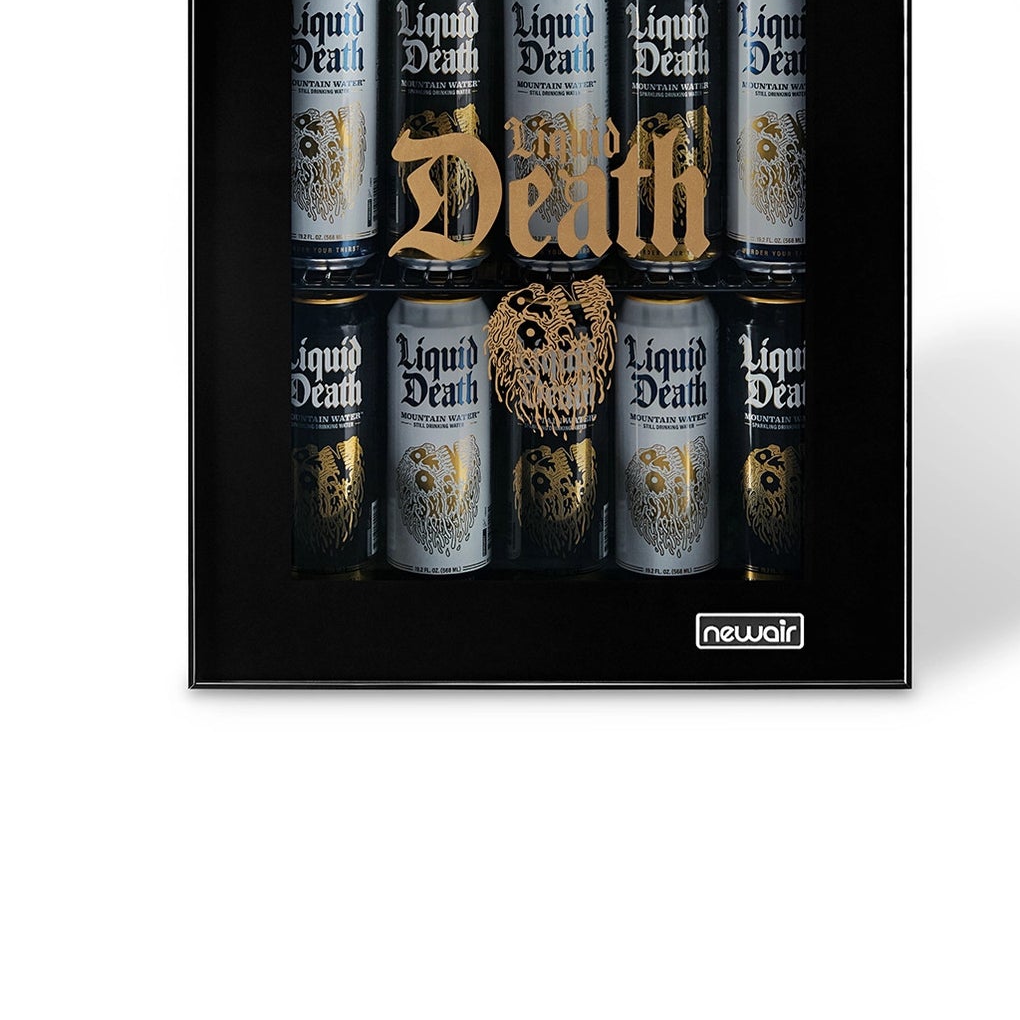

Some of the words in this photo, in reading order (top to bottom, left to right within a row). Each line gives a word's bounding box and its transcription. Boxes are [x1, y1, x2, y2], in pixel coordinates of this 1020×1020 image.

[396, 0, 480, 48] Liquid
[511, 1, 595, 49] Liquid
[624, 1, 710, 49] Liquid
[400, 36, 480, 75] Death
[517, 38, 595, 76] Death
[631, 39, 710, 78] Death
[332, 79, 362, 88] WATER
[401, 79, 448, 89] MOUNTAIN
[449, 79, 478, 89] WATER
[517, 80, 564, 91] MOUNTAIN
[565, 81, 594, 90] WATER
[631, 82, 679, 92] MOUNTAIN
[680, 82, 709, 91] WATER
[504, 116, 620, 165] Liquid
[387, 127, 711, 261] Death
[395, 332, 478, 382] Liquid
[623, 333, 707, 383] Liquid
[401, 370, 479, 407] Death
[630, 371, 708, 409] Death
[331, 412, 362, 422] WATER
[401, 411, 446, 423] MOUNTAIN
[630, 412, 679, 423] MOUNTAIN
[679, 412, 707, 423] WATER
[744, 412, 791, 423] MOUNTAIN
[703, 618, 797, 643] newair
